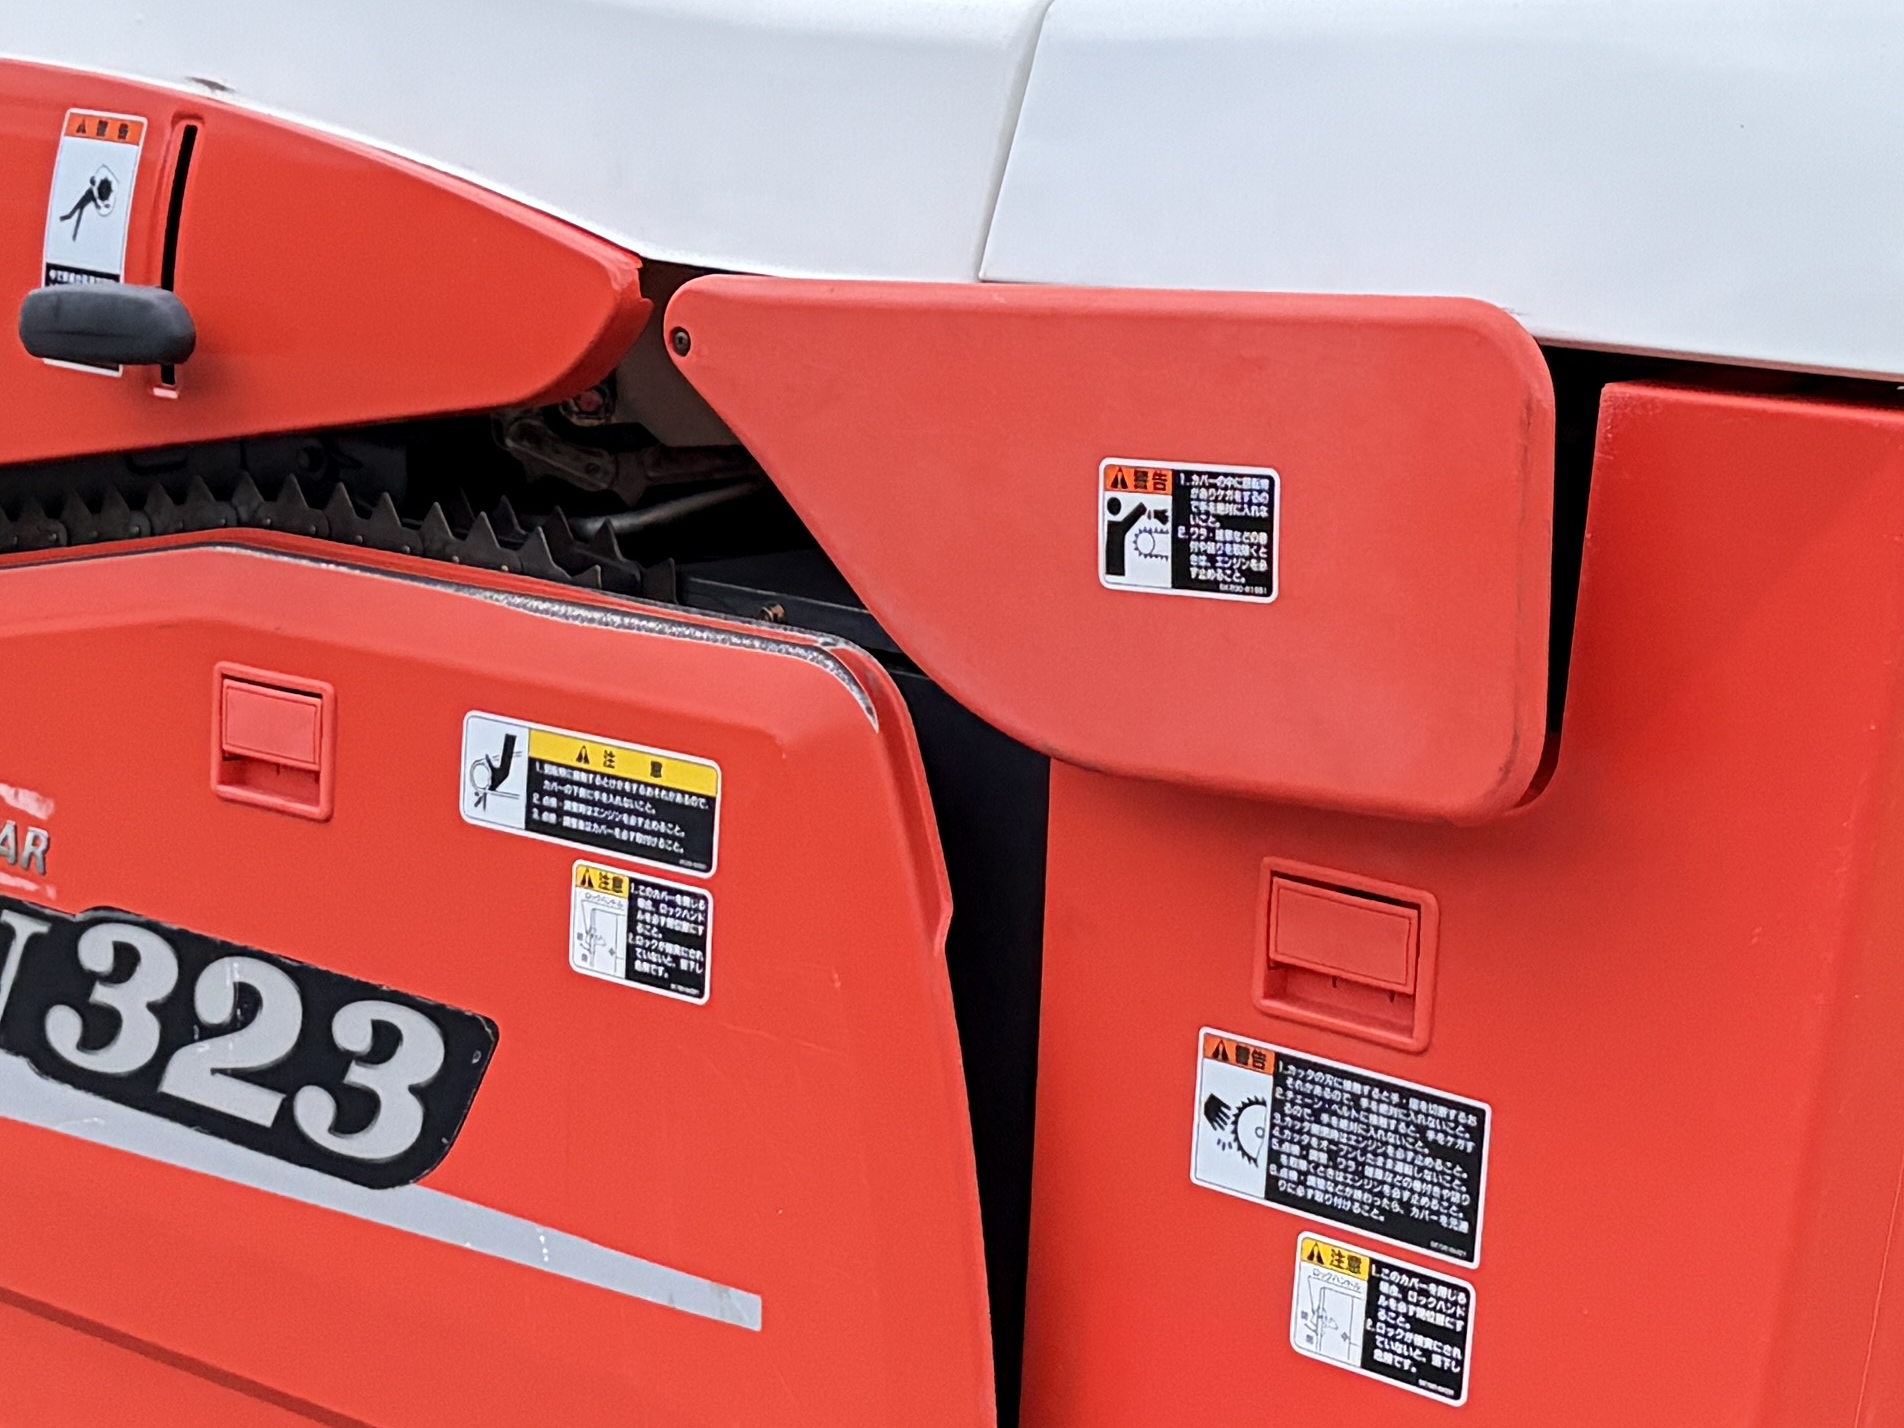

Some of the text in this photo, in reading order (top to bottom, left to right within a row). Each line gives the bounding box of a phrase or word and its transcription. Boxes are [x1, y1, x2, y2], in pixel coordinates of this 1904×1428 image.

[43, 921, 448, 1162] 323
[1235, 1045, 1267, 1070] 警告
[1330, 1248, 1362, 1274] 注意
